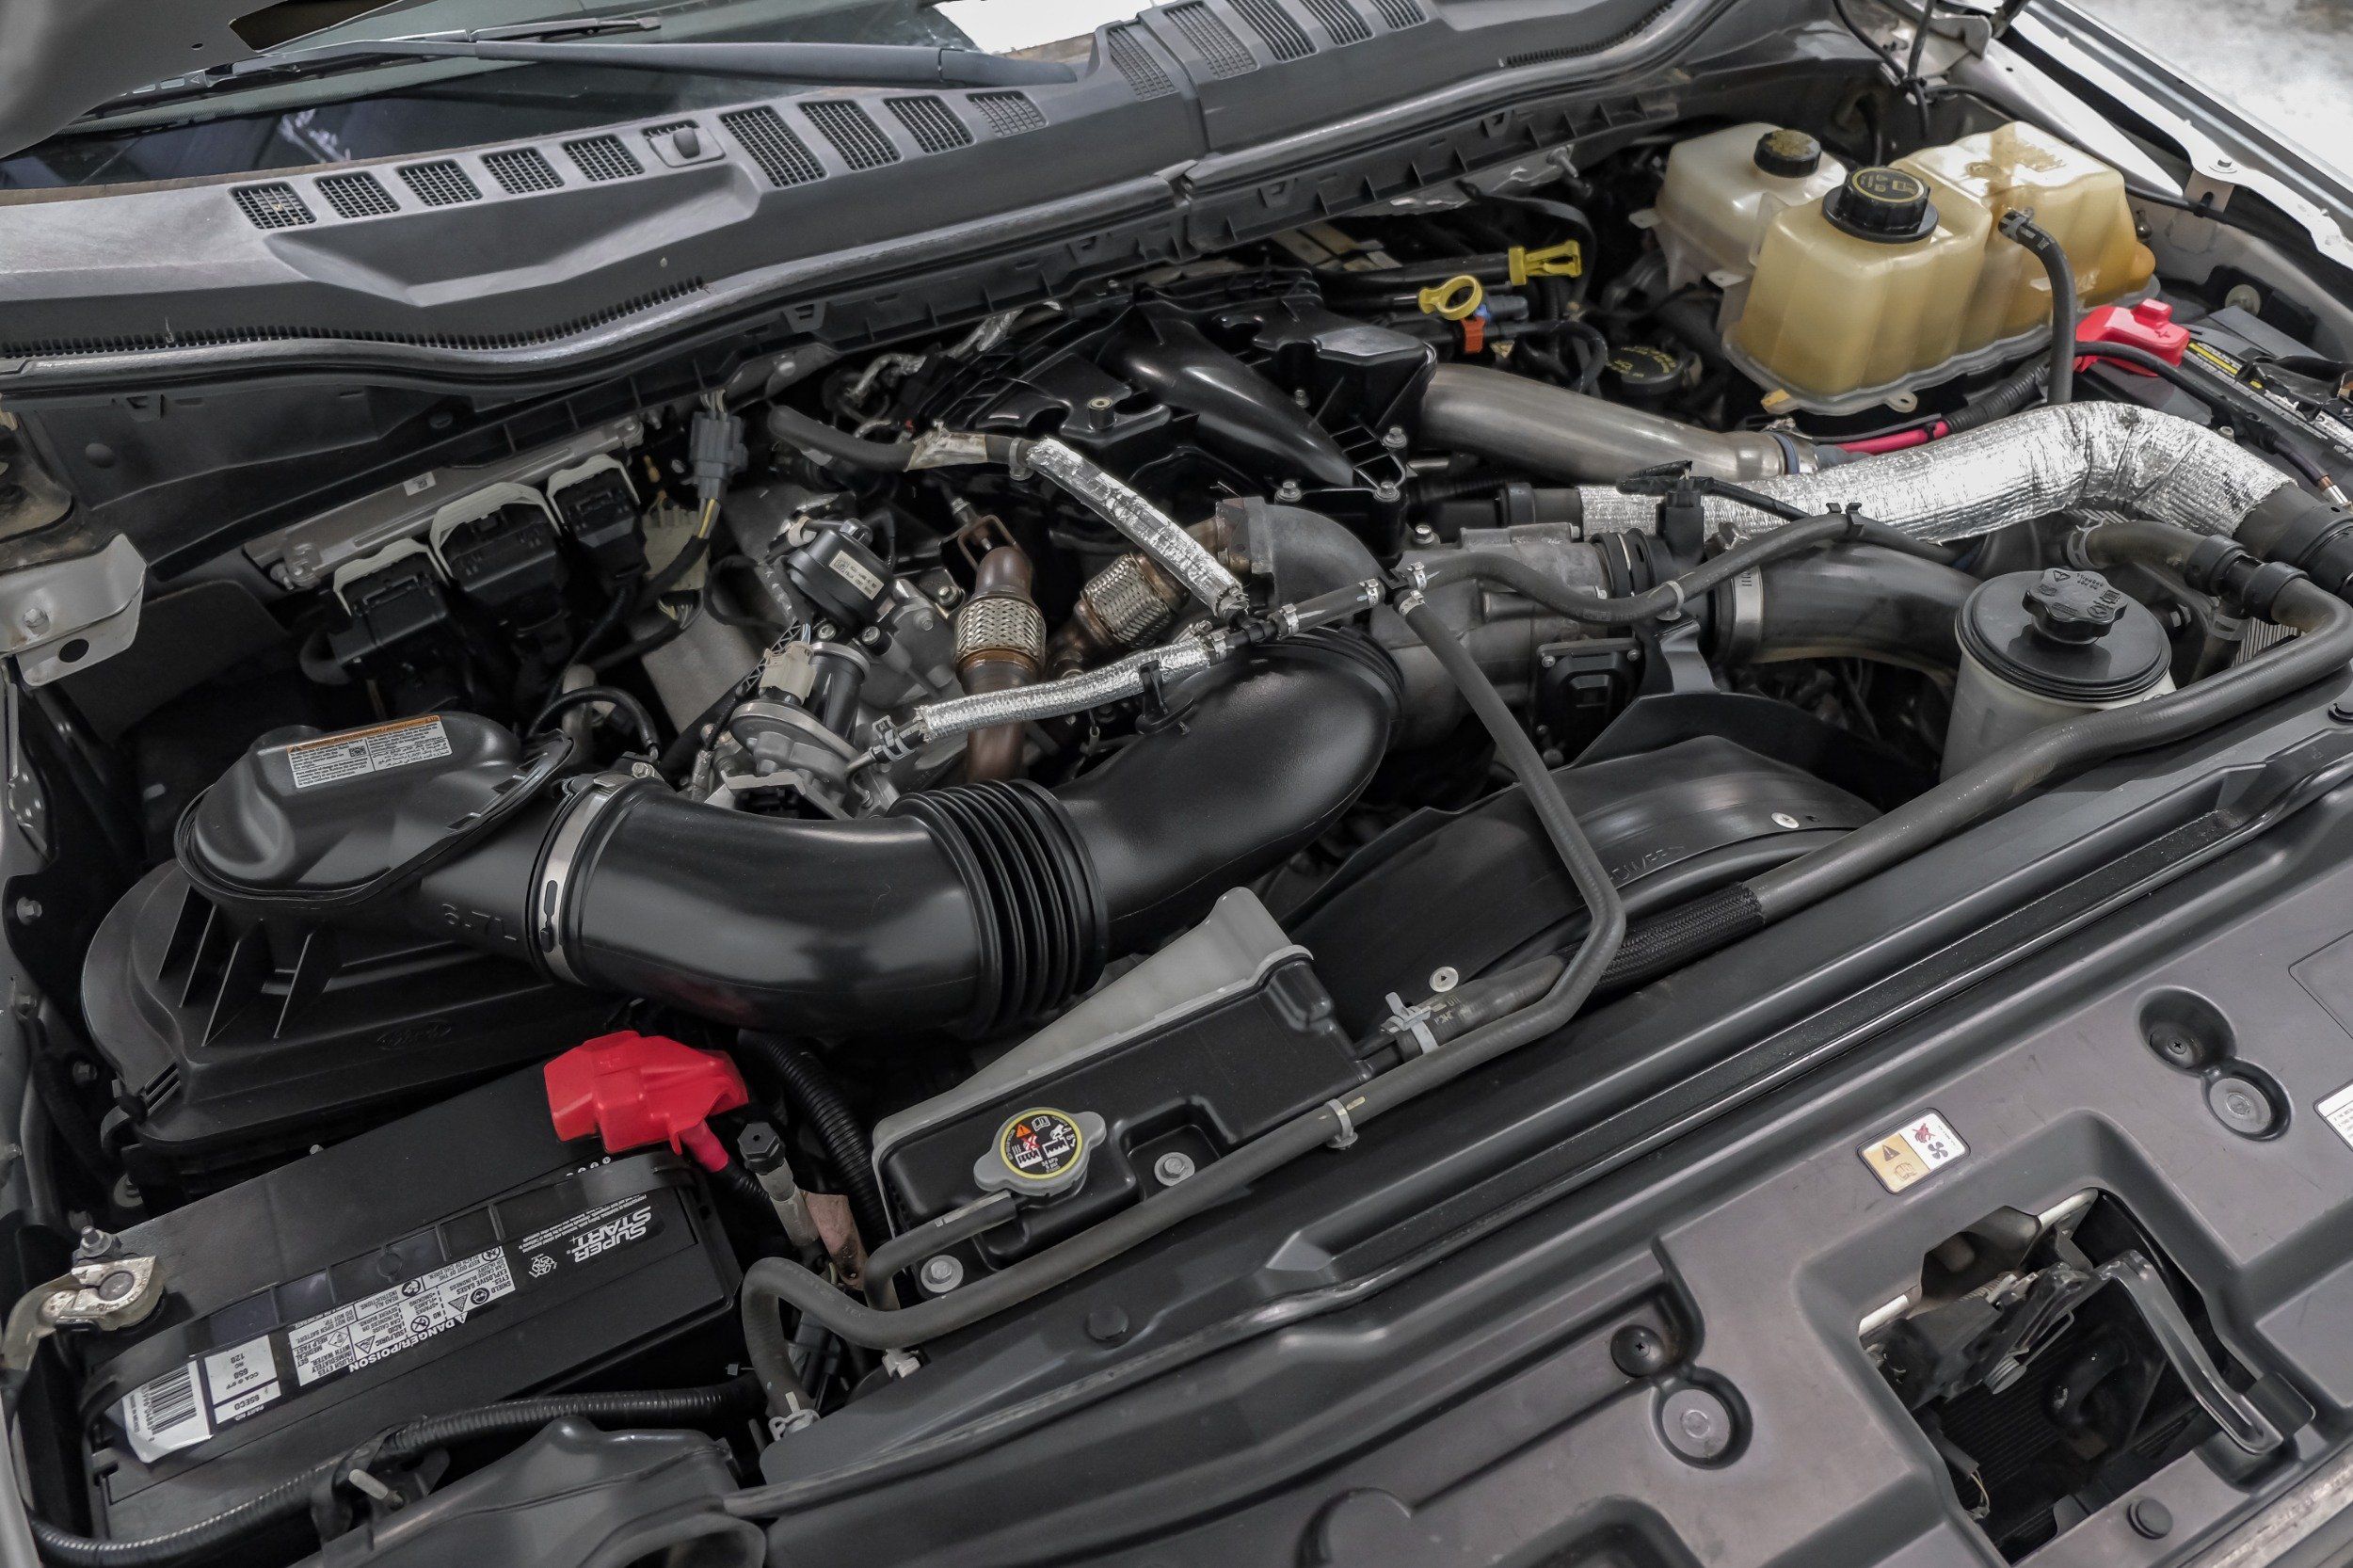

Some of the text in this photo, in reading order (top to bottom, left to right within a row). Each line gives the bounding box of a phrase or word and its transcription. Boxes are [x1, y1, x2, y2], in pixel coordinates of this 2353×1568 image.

[570, 1205, 652, 1255] START
[573, 1224, 647, 1263] SUPER
[456, 1267, 506, 1295] EXPLOSIVE GASES
[490, 1279, 511, 1293] SHIELD
[374, 1294, 398, 1309] READ ALL
[332, 1312, 344, 1321] NOT
[432, 1310, 441, 1319] NO
[371, 1321, 389, 1334] CAUSE
[387, 1322, 402, 1334] ACID
[311, 1336, 328, 1347] HELP
[374, 1328, 405, 1347] SULFURIC
[334, 1343, 350, 1354] WITH
[346, 1318, 456, 1373] DANGER/POISON
[230, 1352, 245, 1364] 120
[295, 1344, 322, 1361] MEDICAL
[296, 1356, 309, 1367] GET
[310, 1349, 352, 1373] IMMEDIATELY
[317, 1355, 353, 1376] FLUSH EYES
[232, 1368, 248, 1379] 650
[244, 1371, 259, 1381] CCA
[245, 1403, 264, 1416] PART
